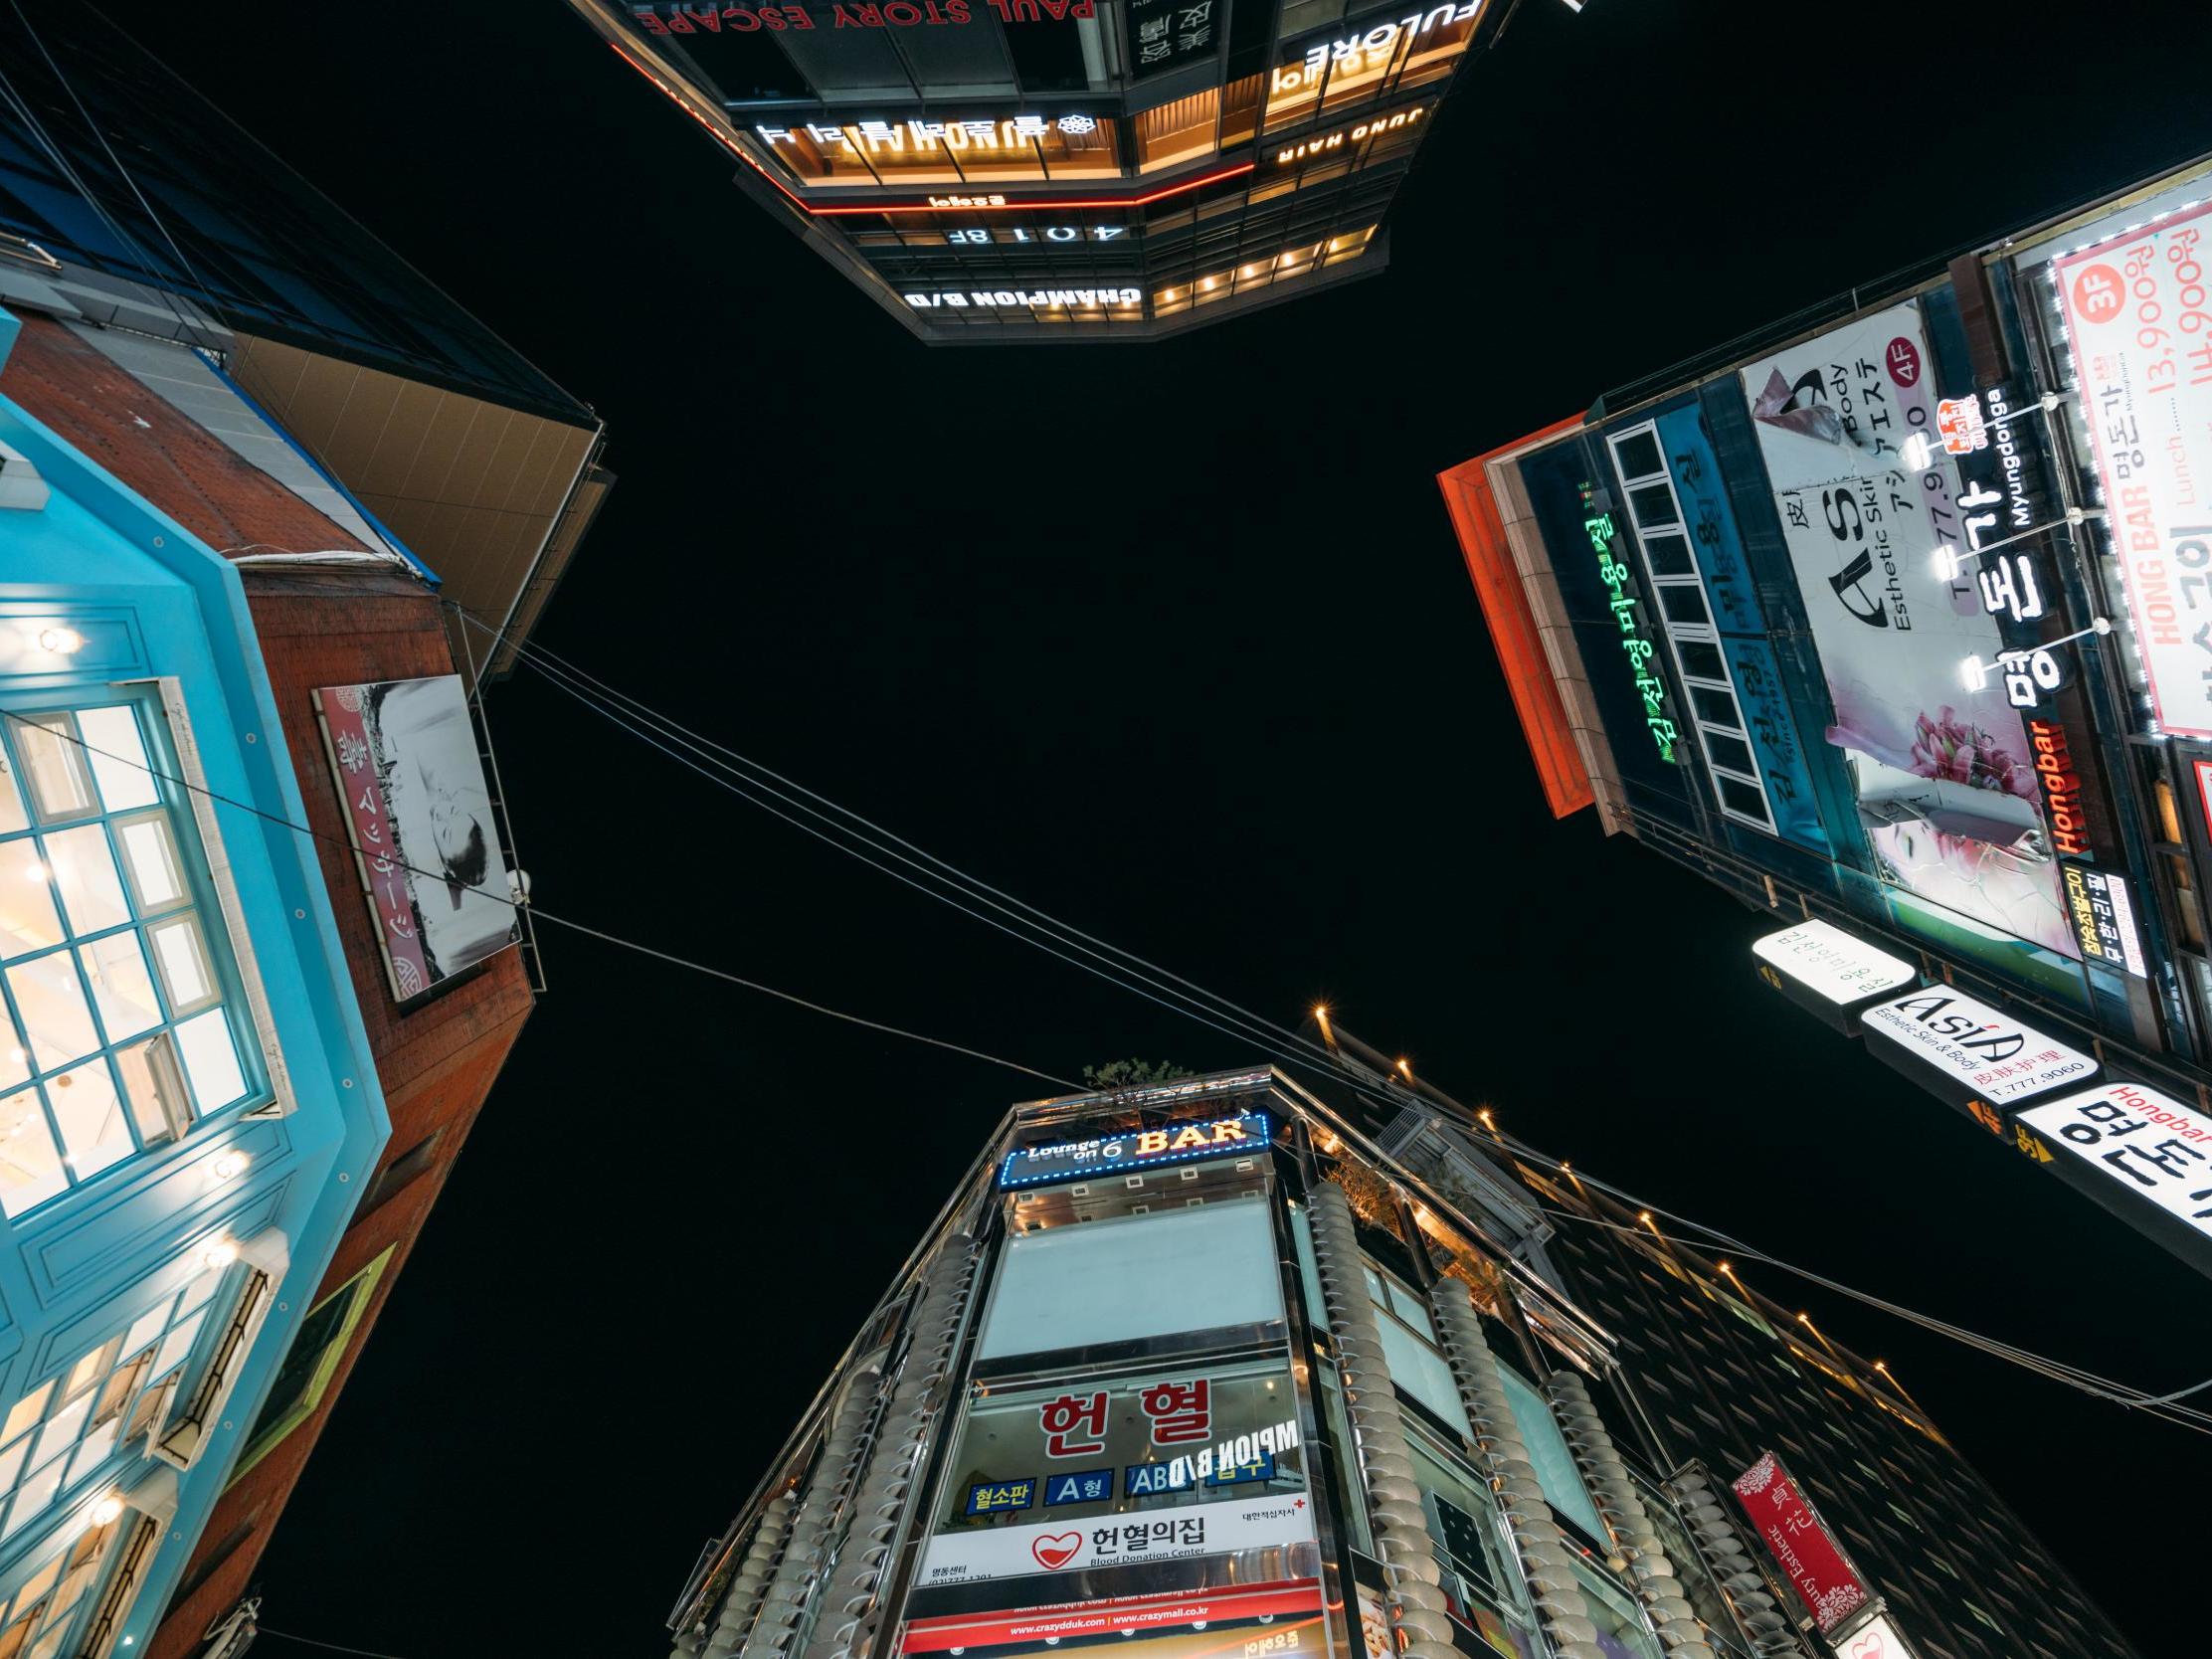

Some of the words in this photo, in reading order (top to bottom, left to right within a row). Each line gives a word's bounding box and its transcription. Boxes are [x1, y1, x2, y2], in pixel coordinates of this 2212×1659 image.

[635, 7, 815, 36] ESCAPE
[833, 0, 972, 28] STORY
[988, 0, 1094, 22] PAUL
[1305, 0, 1480, 67] FULORE
[1352, 107, 1423, 141] JUNO
[1278, 132, 1345, 164] HAIR
[904, 291, 969, 307] B/D
[973, 287, 1142, 307] CHAMPION
[2083, 275, 2117, 314] 3F
[2124, 244, 2176, 395] 13,900원
[1890, 341, 1918, 381] 4F
[1830, 363, 1858, 434] Body
[1987, 389, 2031, 526] Myungdonga
[2121, 484, 2160, 551] BAR
[1876, 529, 1913, 631] Esthetic
[1958, 480, 2060, 708] 명돈가
[2137, 559, 2182, 645] HONG
[1585, 506, 1676, 761] 김선영미용실
[2030, 719, 2076, 856] Hongbar
[357, 785, 415, 941] マッサージ
[1875, 1007, 1913, 1035] Esthetic
[1912, 1029, 1938, 1049] Skin
[1947, 1048, 1981, 1072] Body
[1973, 1048, 2065, 1089] 皮肤护理
[1989, 1060, 2086, 1098] T.777.9060
[1027, 1139, 1101, 1160] Lounge
[1073, 1148, 1097, 1161] on
[1101, 1140, 1123, 1159] 6
[1135, 1120, 1247, 1155] BAR
[975, 1484, 1030, 1511] 혈소판
[1056, 1478, 1083, 1501] A
[1083, 1480, 1104, 1500] 형
[1090, 1516, 1205, 1556] 헌혈의집
[1767, 1523, 1805, 1580] Esthetic
[930, 1565, 968, 1577] 명동센터
[1090, 1554, 1118, 1567] Blood
[1119, 1550, 1170, 1566] Donation
[1172, 1547, 1205, 1562] Center
[1011, 1616, 1106, 1636] www.crazydduk.com
[1112, 1605, 1209, 1626] www.crazymall.co.kr
